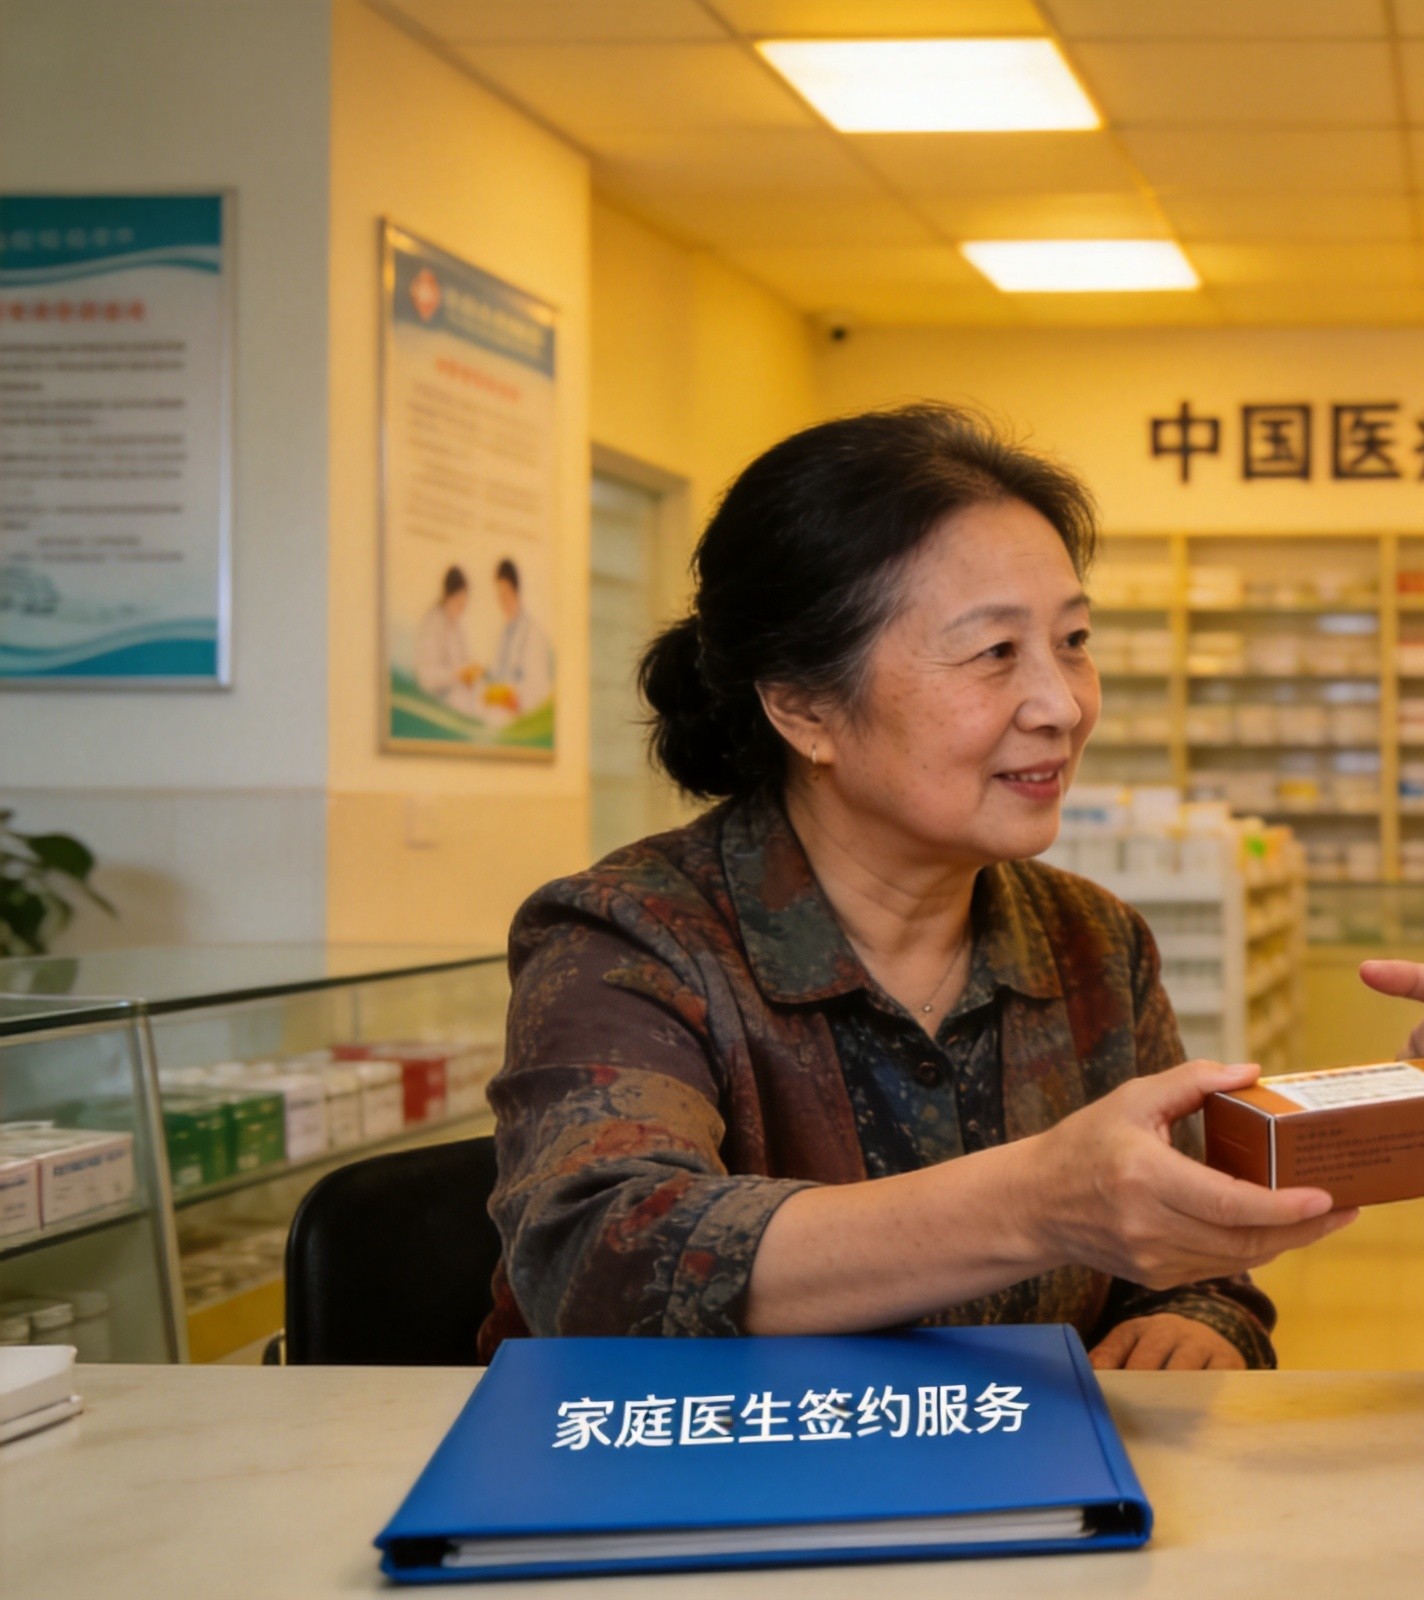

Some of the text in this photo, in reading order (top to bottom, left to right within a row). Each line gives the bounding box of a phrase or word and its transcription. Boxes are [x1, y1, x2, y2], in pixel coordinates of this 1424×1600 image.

[552, 1382, 1031, 1451] 家庭医生签约服务
